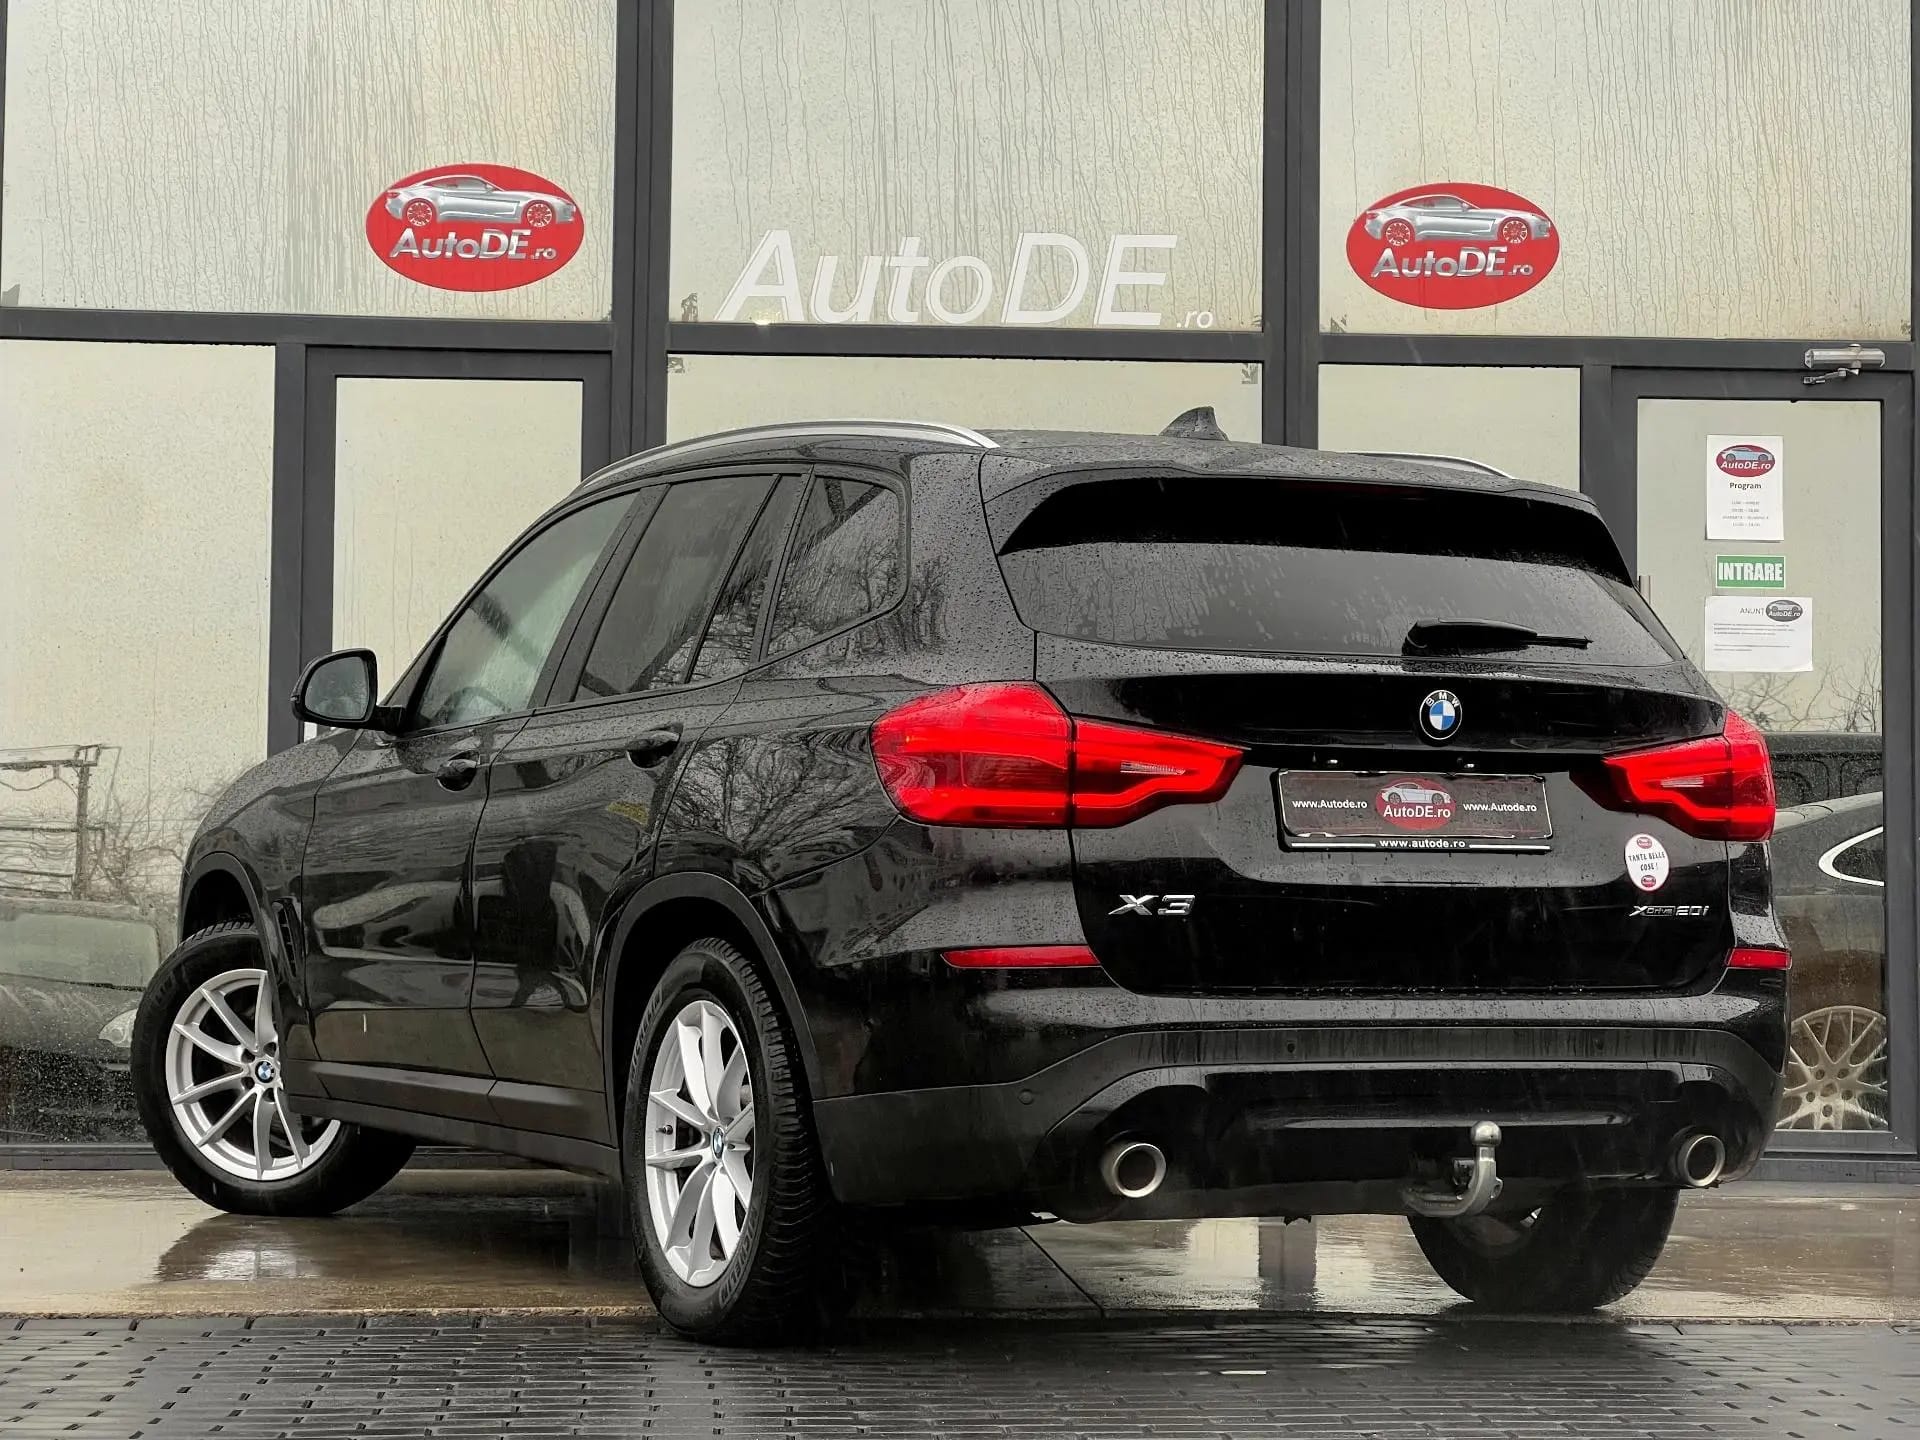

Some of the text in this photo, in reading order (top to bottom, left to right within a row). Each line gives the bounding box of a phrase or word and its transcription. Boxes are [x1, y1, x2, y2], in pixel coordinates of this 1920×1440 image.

[1729, 482, 1762, 491] Program
[1718, 562, 1783, 581] INTRARE
[1383, 805, 1451, 819] AutoDE.ro
[1379, 838, 1466, 849] www.autode.ro
[1628, 853, 1647, 862] TANTE
